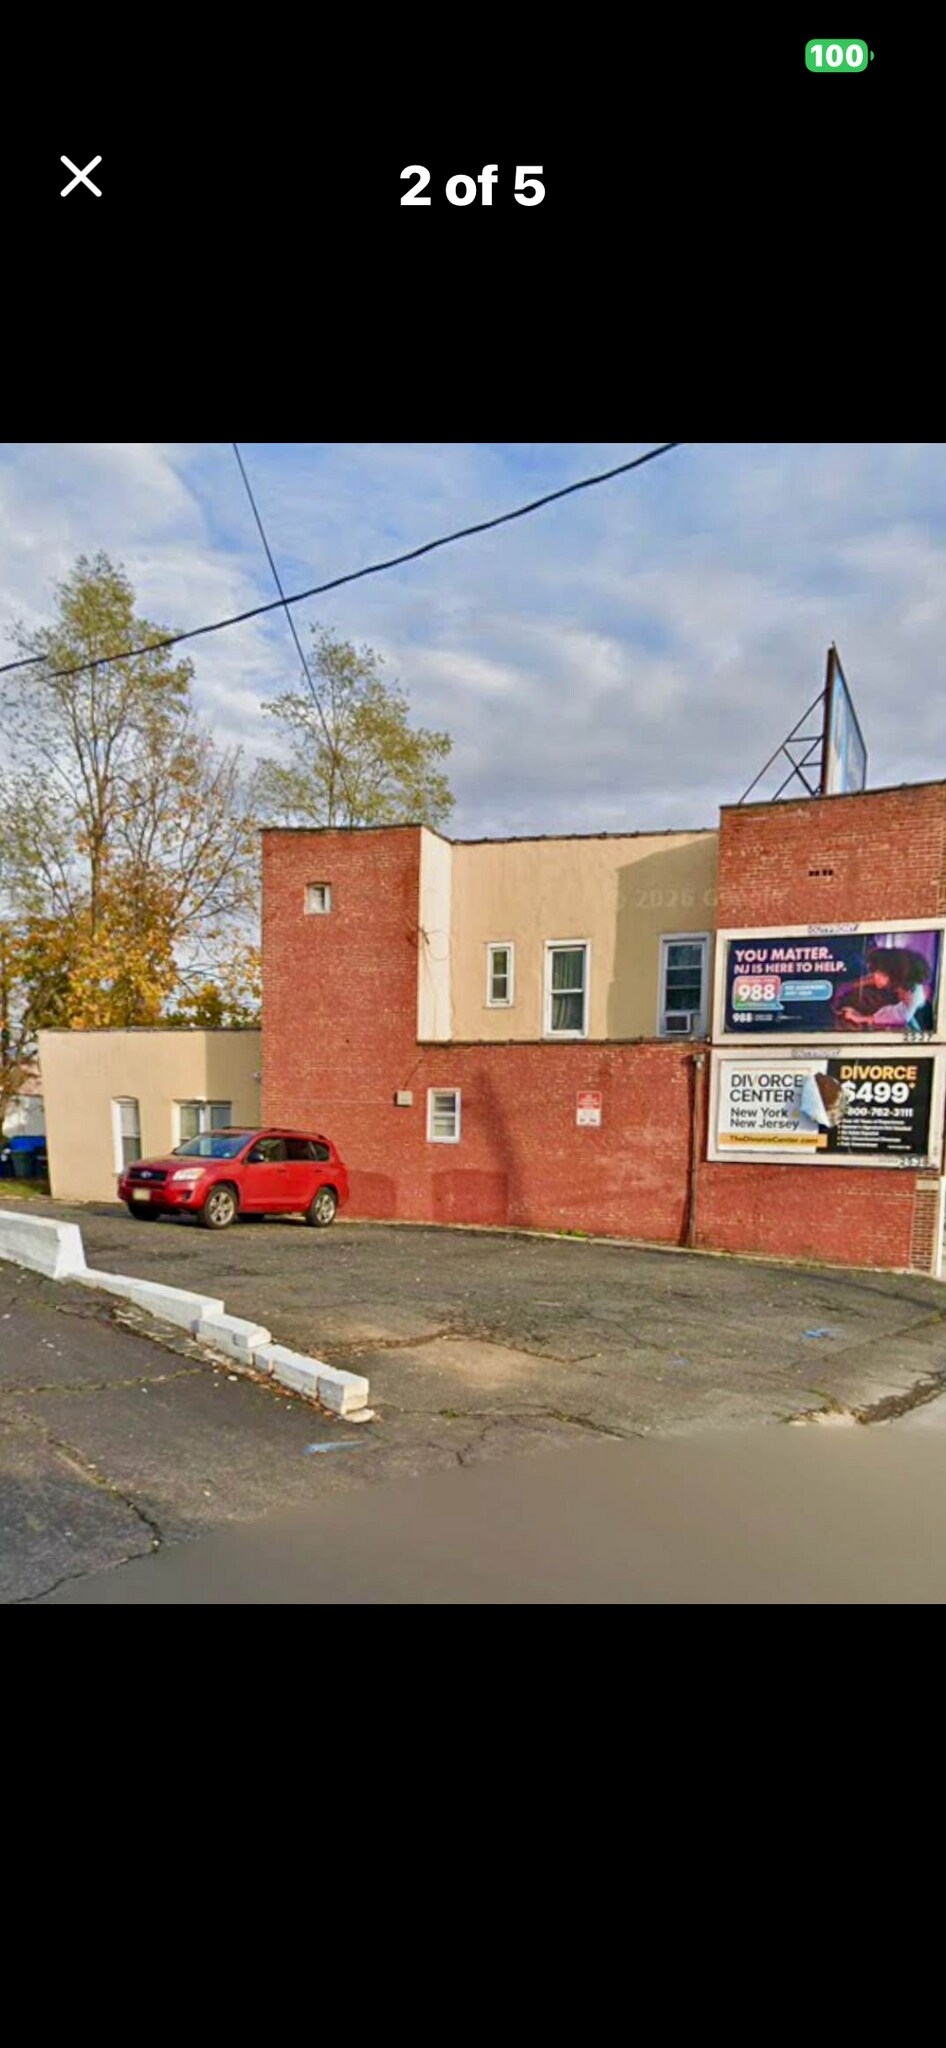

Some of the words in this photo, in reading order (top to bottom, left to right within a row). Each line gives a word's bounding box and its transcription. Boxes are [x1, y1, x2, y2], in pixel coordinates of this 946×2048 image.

[735, 949, 768, 962] YOU
[771, 946, 833, 961] MATTER.
[734, 964, 750, 974] NJ
[752, 963, 763, 973] IS
[766, 962, 794, 973] HERE
[796, 961, 812, 973] TO
[814, 960, 847, 973] HELP.
[738, 983, 775, 1001] 988
[732, 1012, 753, 1023] 988
[841, 1065, 917, 1080] DIVORCE
[731, 1074, 804, 1088] DIVORCE
[729, 1089, 794, 1102] CENTER
[730, 1107, 757, 1118] New
[761, 1107, 788, 1118] York
[730, 1118, 757, 1128] New
[759, 1119, 799, 1131] Jersey
